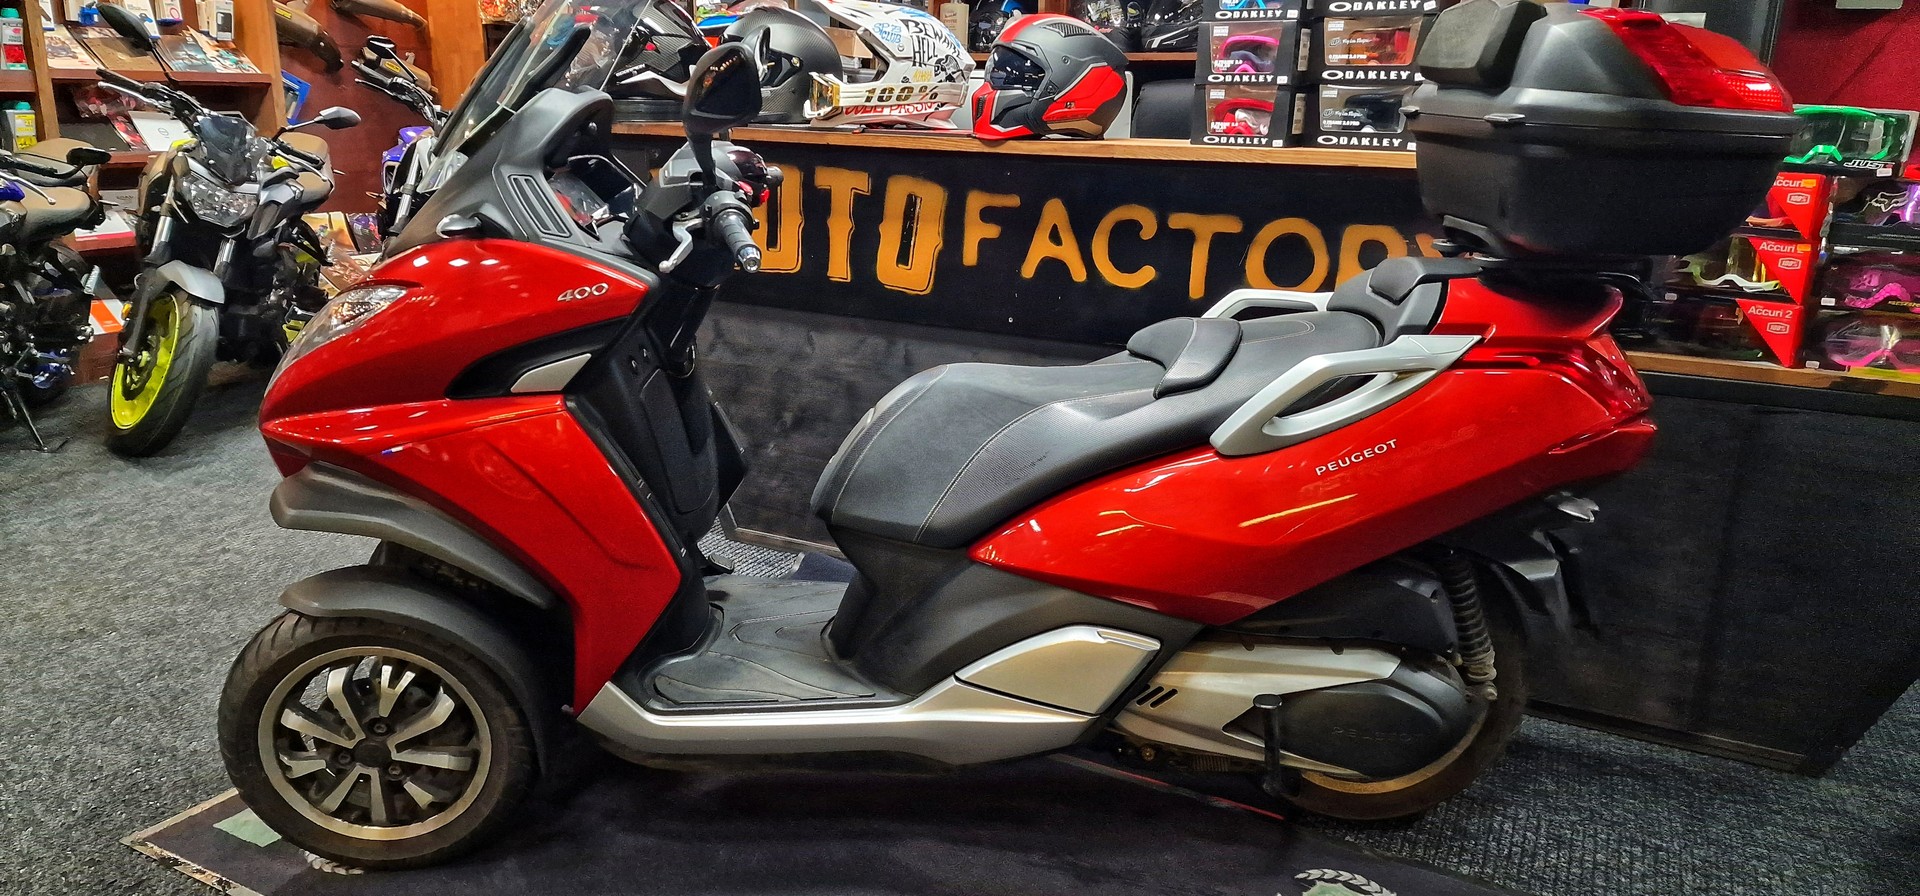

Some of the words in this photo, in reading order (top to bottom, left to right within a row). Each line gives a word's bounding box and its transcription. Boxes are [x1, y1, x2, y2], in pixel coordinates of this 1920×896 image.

[1353, 0, 1421, 11] OAKLEY
[1233, 9, 1283, 19] OAKLEY
[910, 35, 938, 67] HELL
[1224, 74, 1275, 82] OAKLEY
[1345, 70, 1411, 80] OAKLEY
[863, 85, 939, 104] 100%
[1220, 136, 1269, 145] OAKLEY
[1340, 136, 1403, 147] OAKLEY
[735, 164, 947, 295] OTO
[1759, 241, 1795, 253] Accuri
[557, 283, 609, 301] 400
[1748, 305, 1783, 318] Accuri
[1785, 310, 1793, 318] 2
[1315, 439, 1397, 475] PEUGEOT
